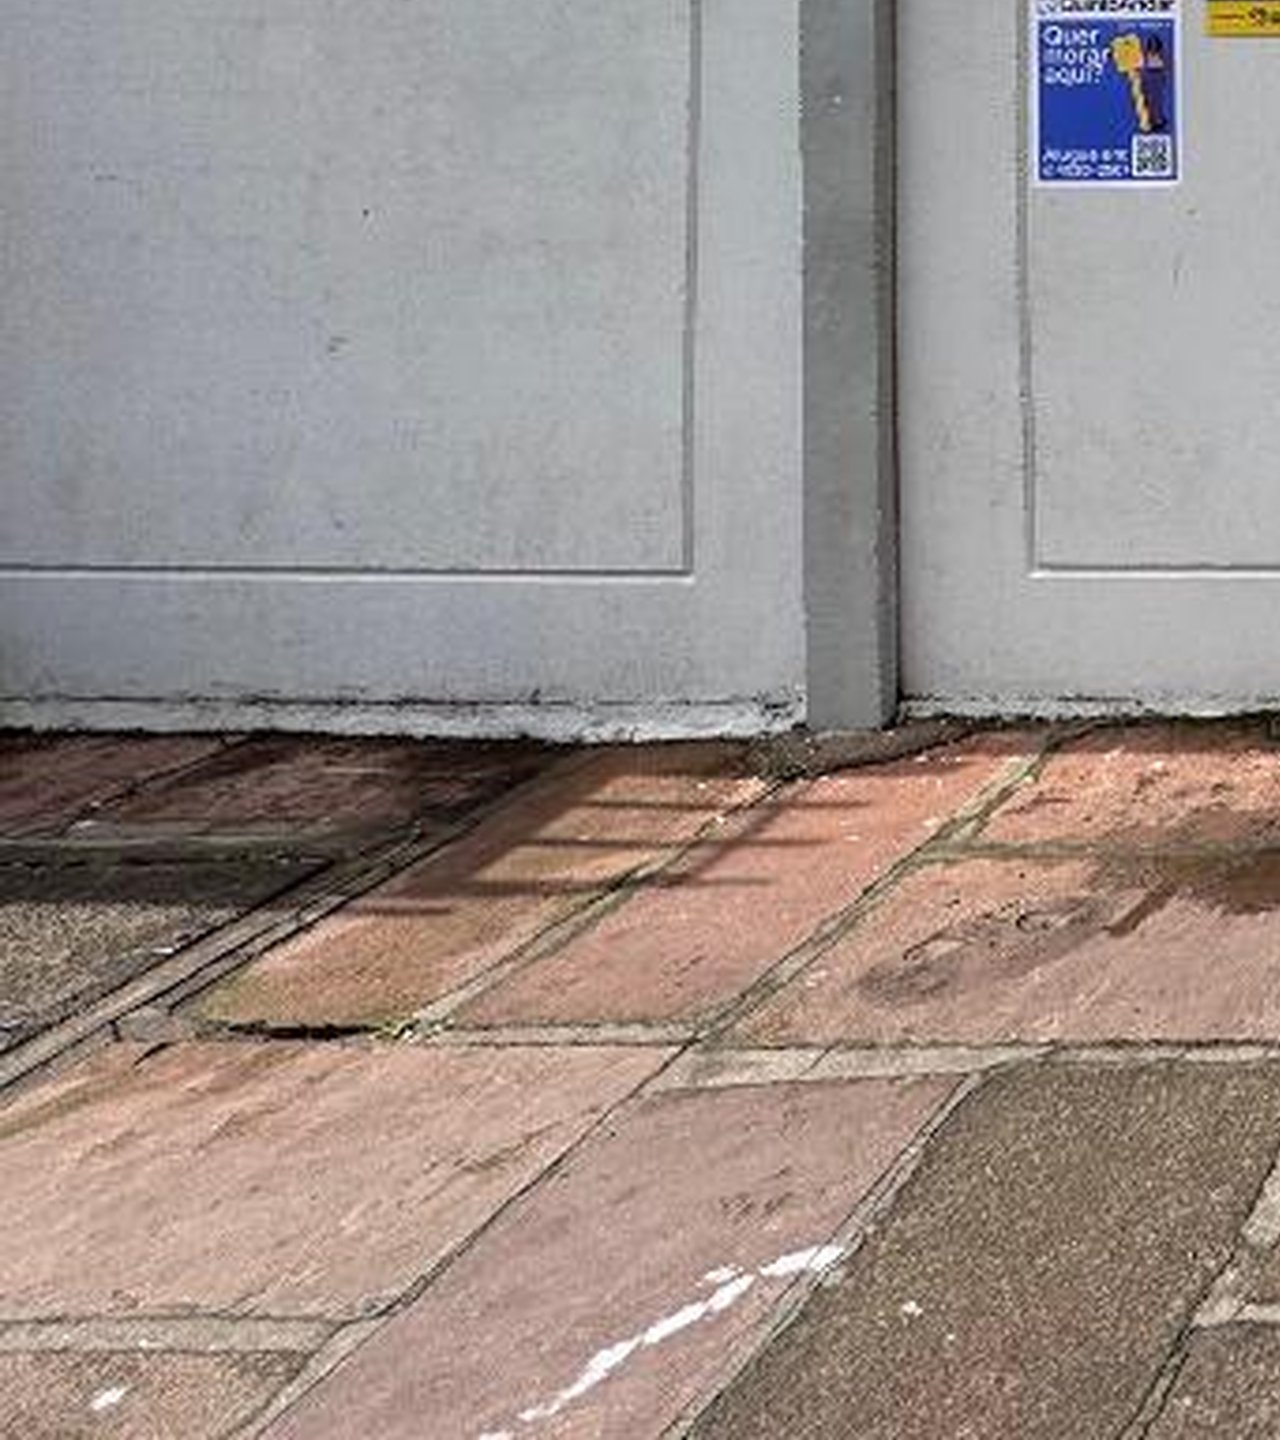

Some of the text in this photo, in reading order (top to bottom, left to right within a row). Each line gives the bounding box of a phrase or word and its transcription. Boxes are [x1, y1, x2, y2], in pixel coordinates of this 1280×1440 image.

[1043, 26, 1100, 46] Quer
[1043, 47, 1111, 65] morar
[1044, 63, 1103, 86] aqui?
